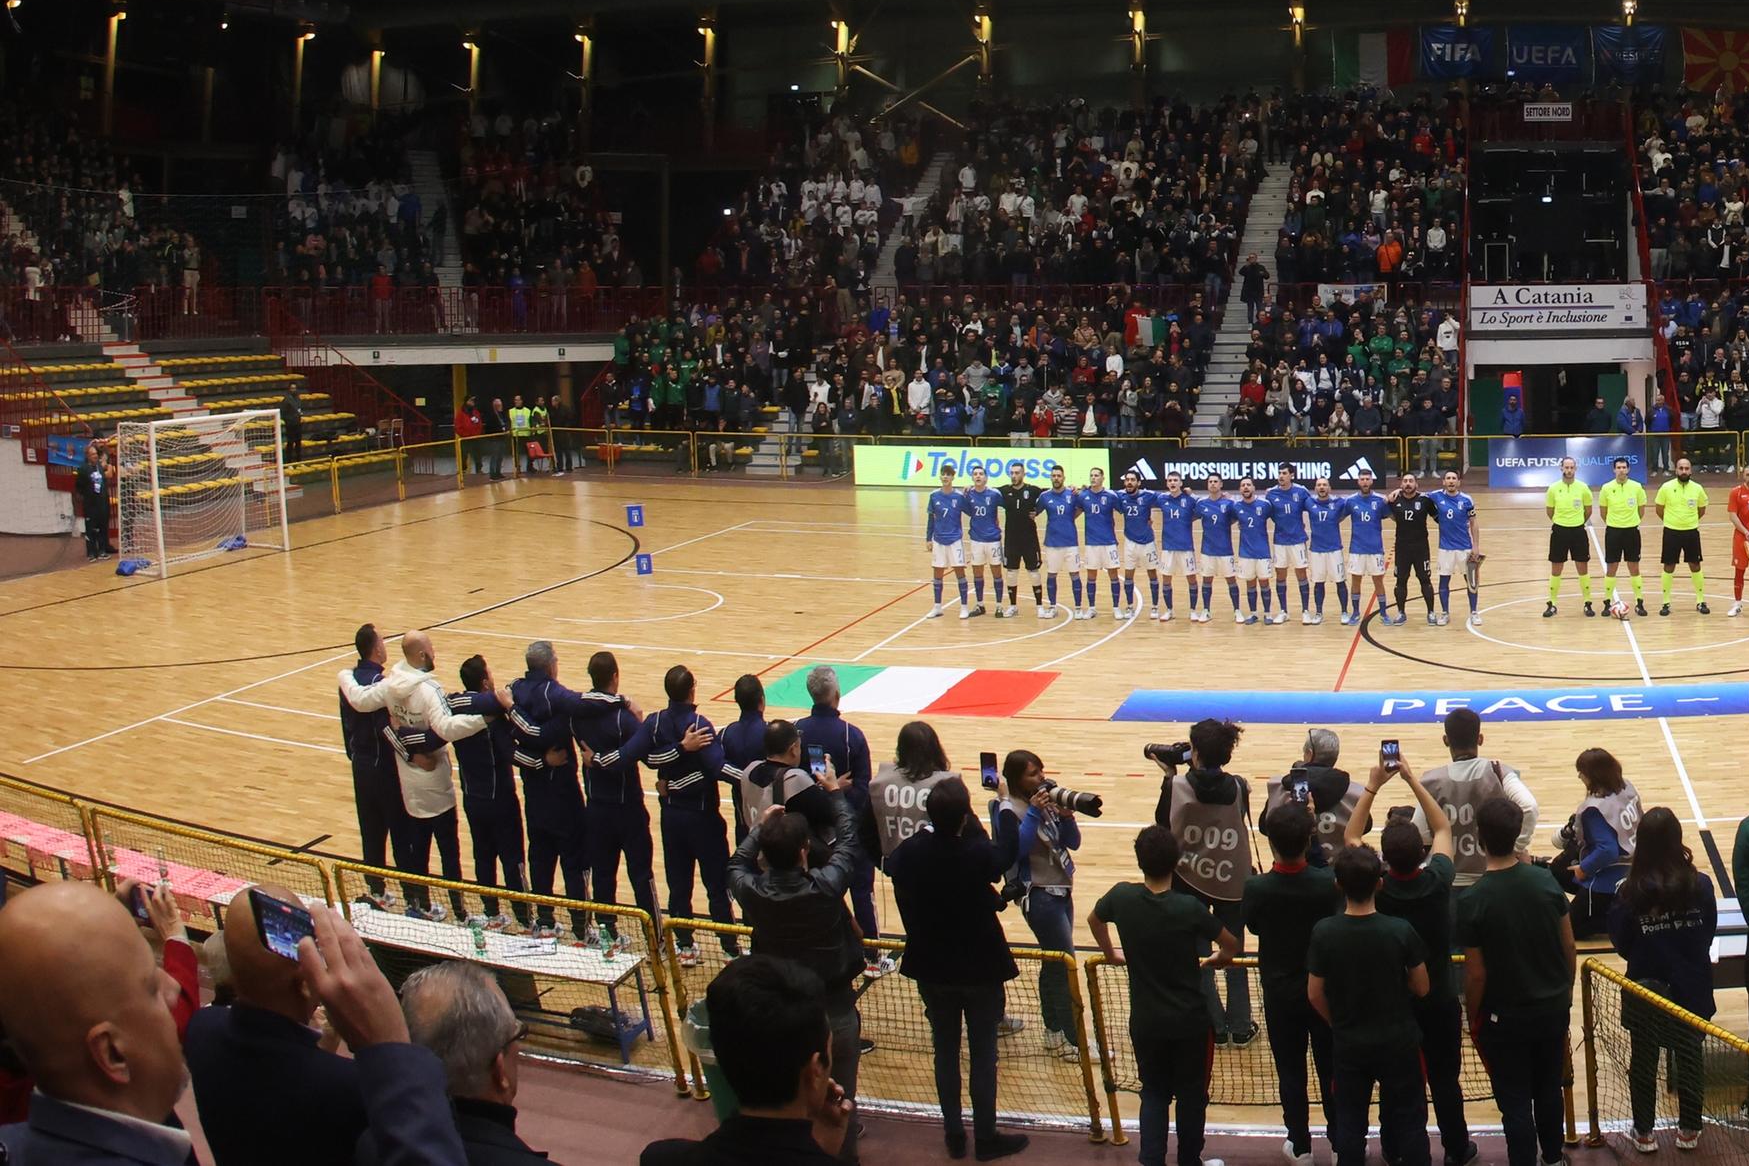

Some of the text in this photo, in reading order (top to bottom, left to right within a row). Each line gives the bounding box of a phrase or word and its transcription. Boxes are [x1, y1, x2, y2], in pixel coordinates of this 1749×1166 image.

[1431, 42, 1481, 62] FIFA
[1513, 45, 1577, 65] UEFA
[1525, 106, 1571, 117] SETTORE NORD
[1492, 287, 1594, 305] A Catania
[1480, 310, 1608, 327] Lo Sport è Inclusione
[1496, 457, 1526, 467] UEFA
[1527, 457, 1564, 467] FUTSA
[1164, 462, 1250, 480] IMPOSSIBILE
[1253, 462, 1267, 479] IS
[942, 507, 949, 518] 7
[974, 505, 987, 516] 20
[1057, 504, 1065, 515] 19
[1091, 504, 1100, 514] 10
[1126, 505, 1139, 516] 23
[1170, 508, 1180, 519] 14
[1284, 503, 1291, 514] 11
[1446, 508, 1454, 519] 8
[1211, 514, 1218, 525] 9
[1318, 511, 1328, 522] 17
[1360, 511, 1371, 522] 16
[1404, 510, 1414, 521] 12
[1247, 516, 1254, 527] 2
[956, 548, 962, 559] 7
[1147, 551, 1158, 562] 23
[1380, 692, 1654, 716] PEACE
[884, 784, 931, 812] 006
[1183, 825, 1239, 851] 009
[1177, 851, 1233, 882] FIGC
